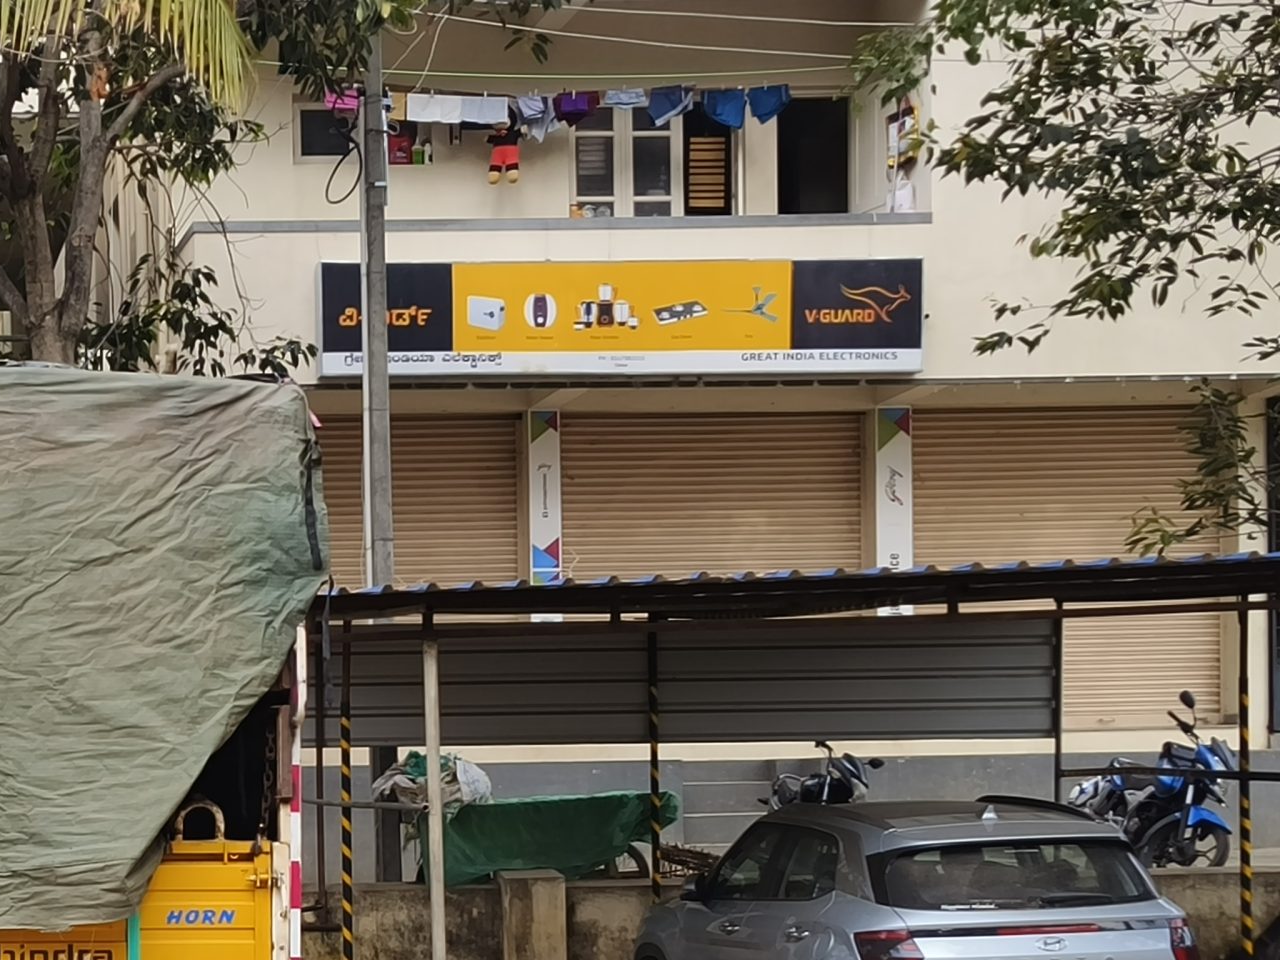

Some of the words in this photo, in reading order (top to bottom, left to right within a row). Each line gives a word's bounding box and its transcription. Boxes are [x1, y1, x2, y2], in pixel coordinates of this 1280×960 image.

[804, 308, 876, 324] V-GUARD
[741, 352, 780, 362] GREAT
[783, 352, 816, 361] INDIA
[820, 351, 898, 361] ELECTRONICS
[166, 909, 236, 926] HORN
